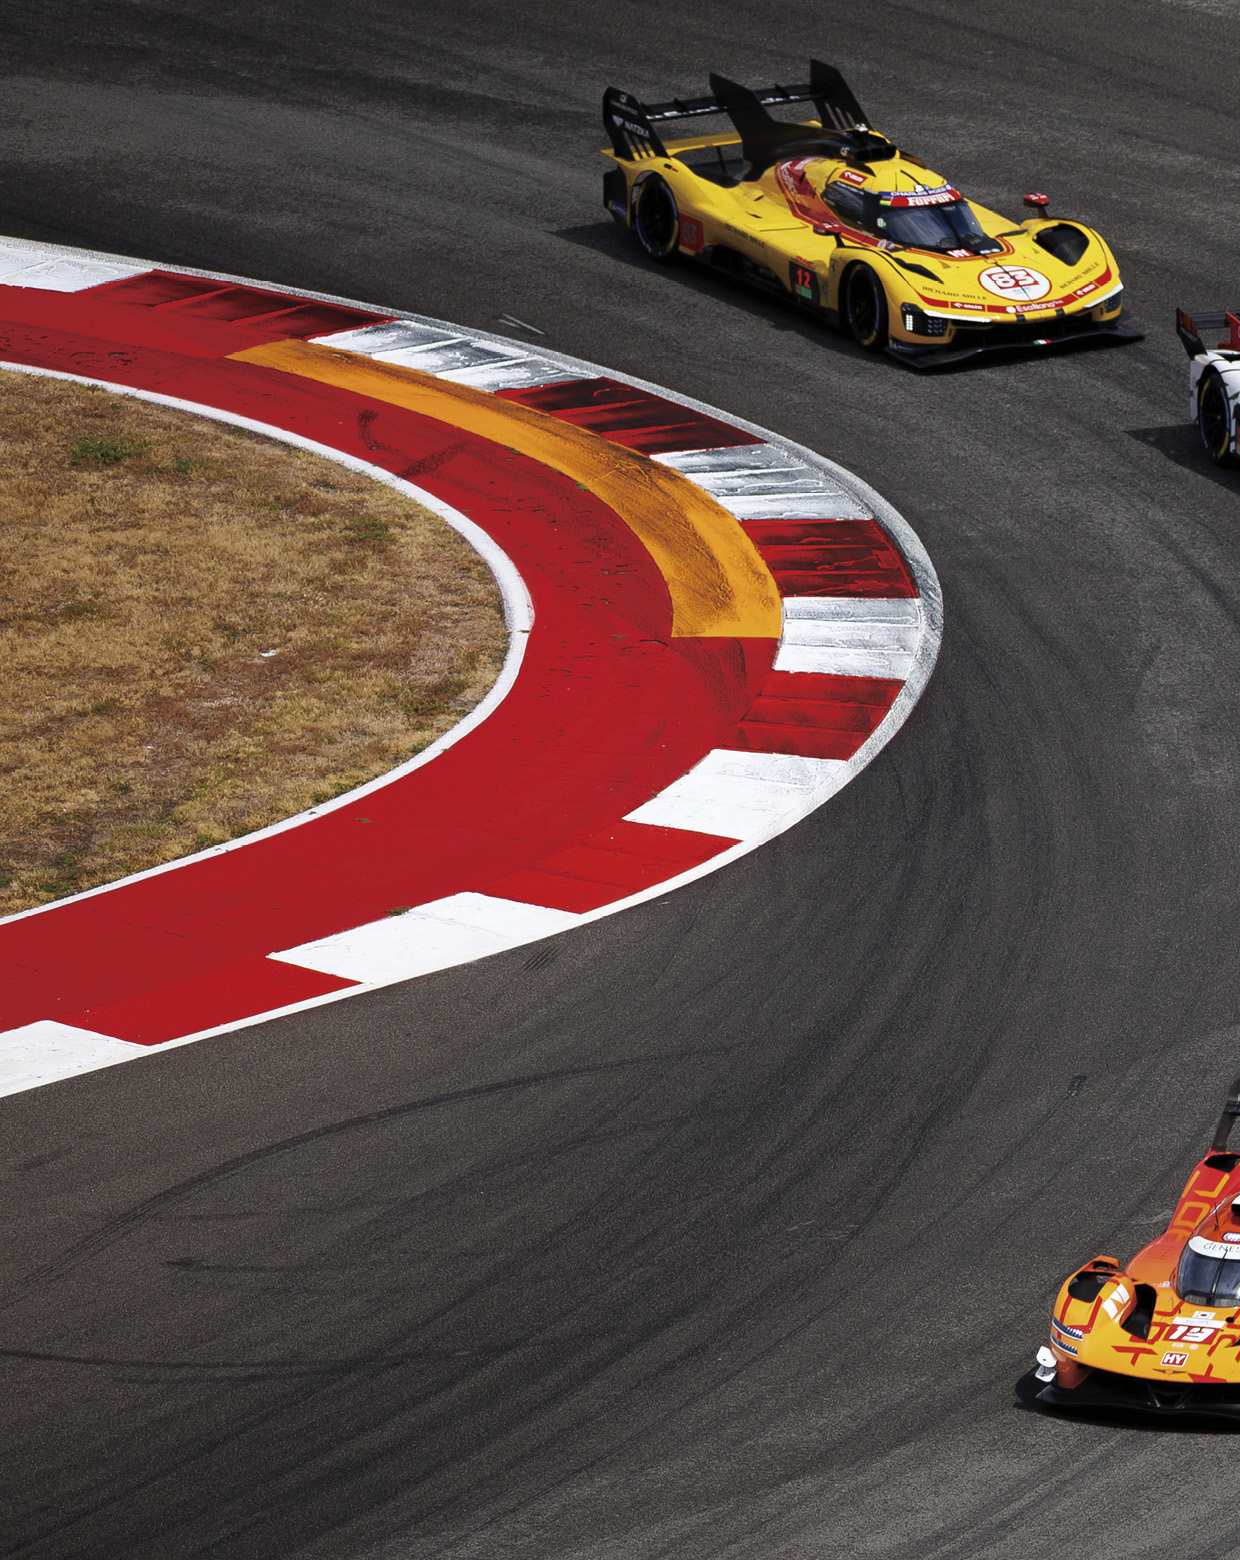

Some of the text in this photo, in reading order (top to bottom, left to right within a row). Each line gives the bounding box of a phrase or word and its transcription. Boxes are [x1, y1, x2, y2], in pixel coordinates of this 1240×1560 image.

[625, 120, 650, 139] NATZKA
[907, 193, 955, 206] Ferrari
[682, 220, 697, 245] 83
[797, 269, 810, 288] 12
[991, 269, 1036, 288] 83
[1168, 1325, 1215, 1342] 19
[1163, 1353, 1186, 1365] HY
